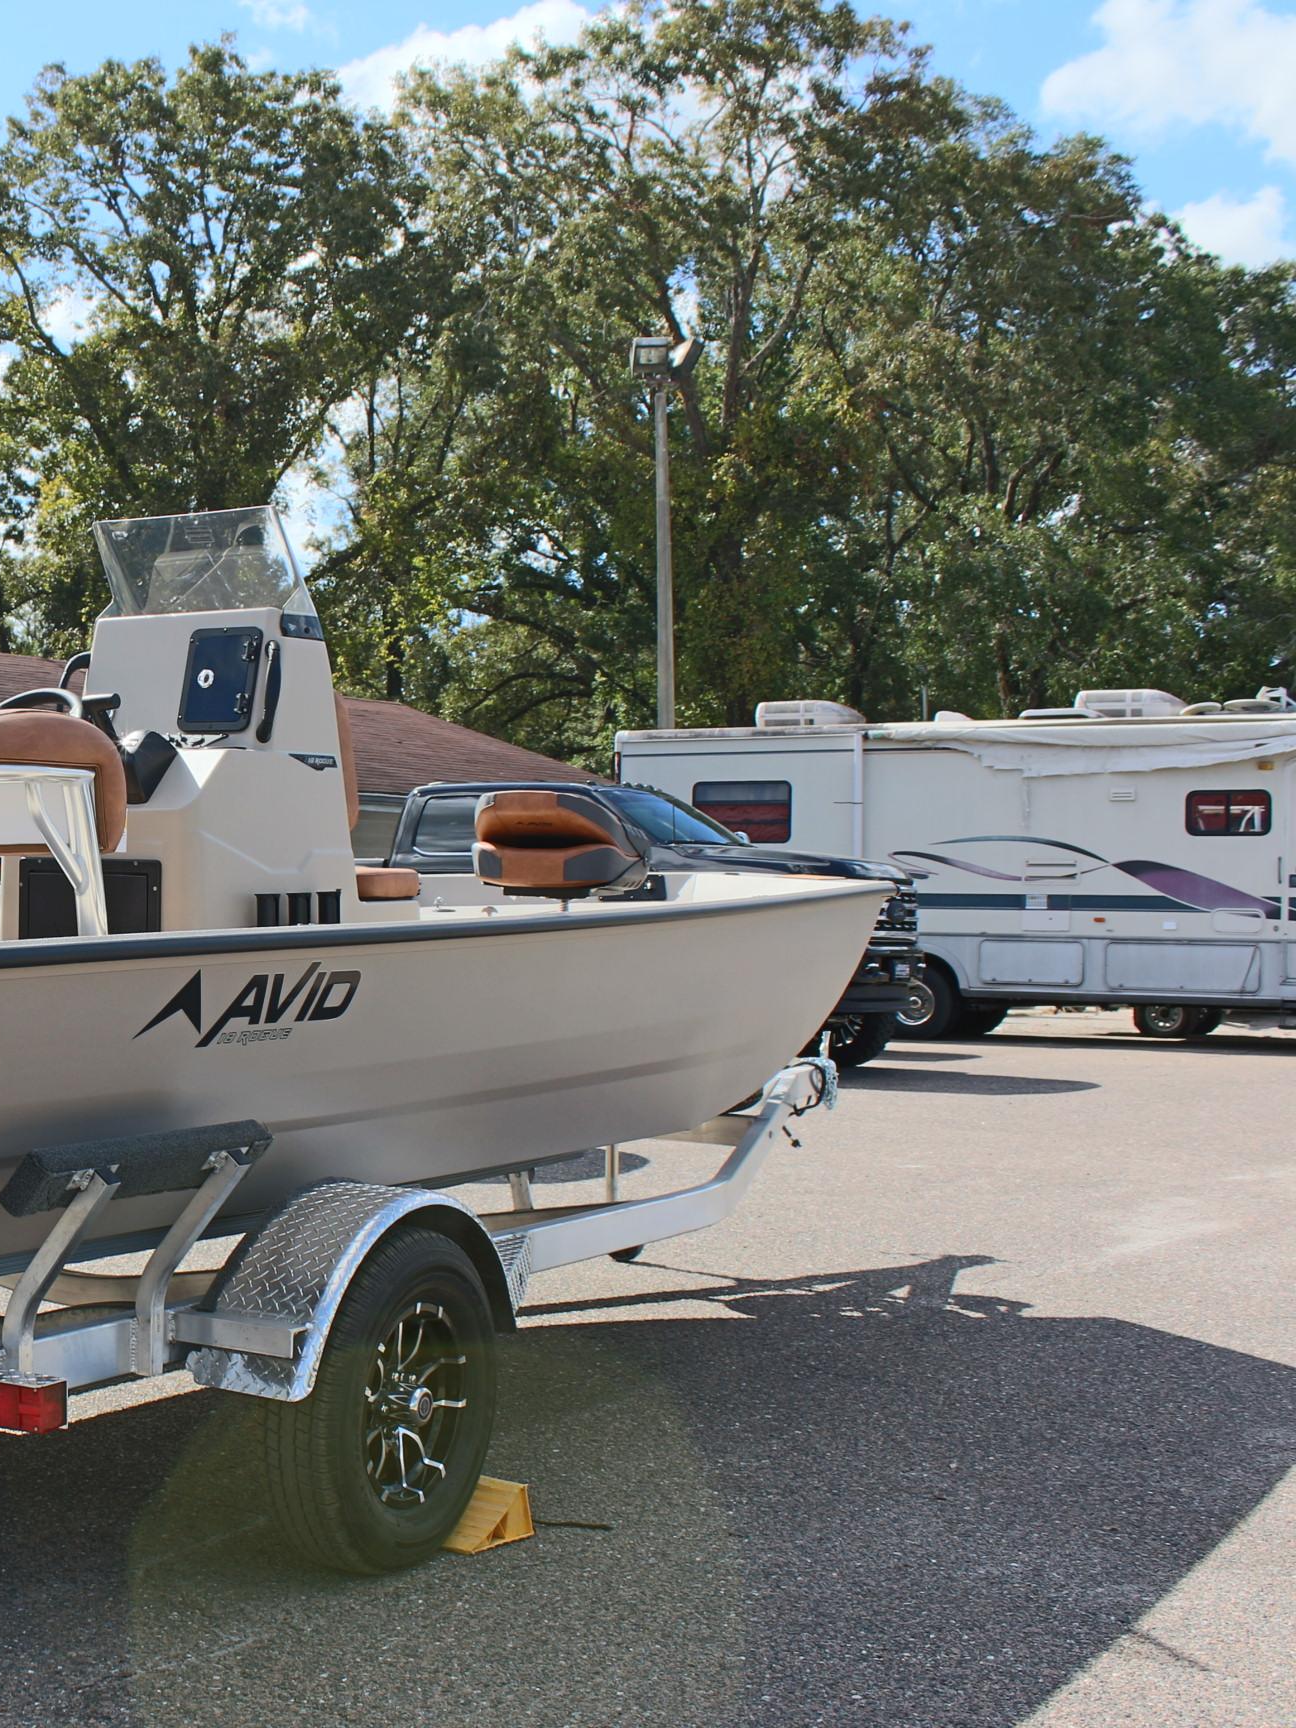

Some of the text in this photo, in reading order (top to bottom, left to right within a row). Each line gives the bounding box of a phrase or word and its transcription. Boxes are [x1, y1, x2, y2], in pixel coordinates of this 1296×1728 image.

[195, 961, 362, 1048] AVID
[216, 1028, 293, 1046] 18 ROGUE
